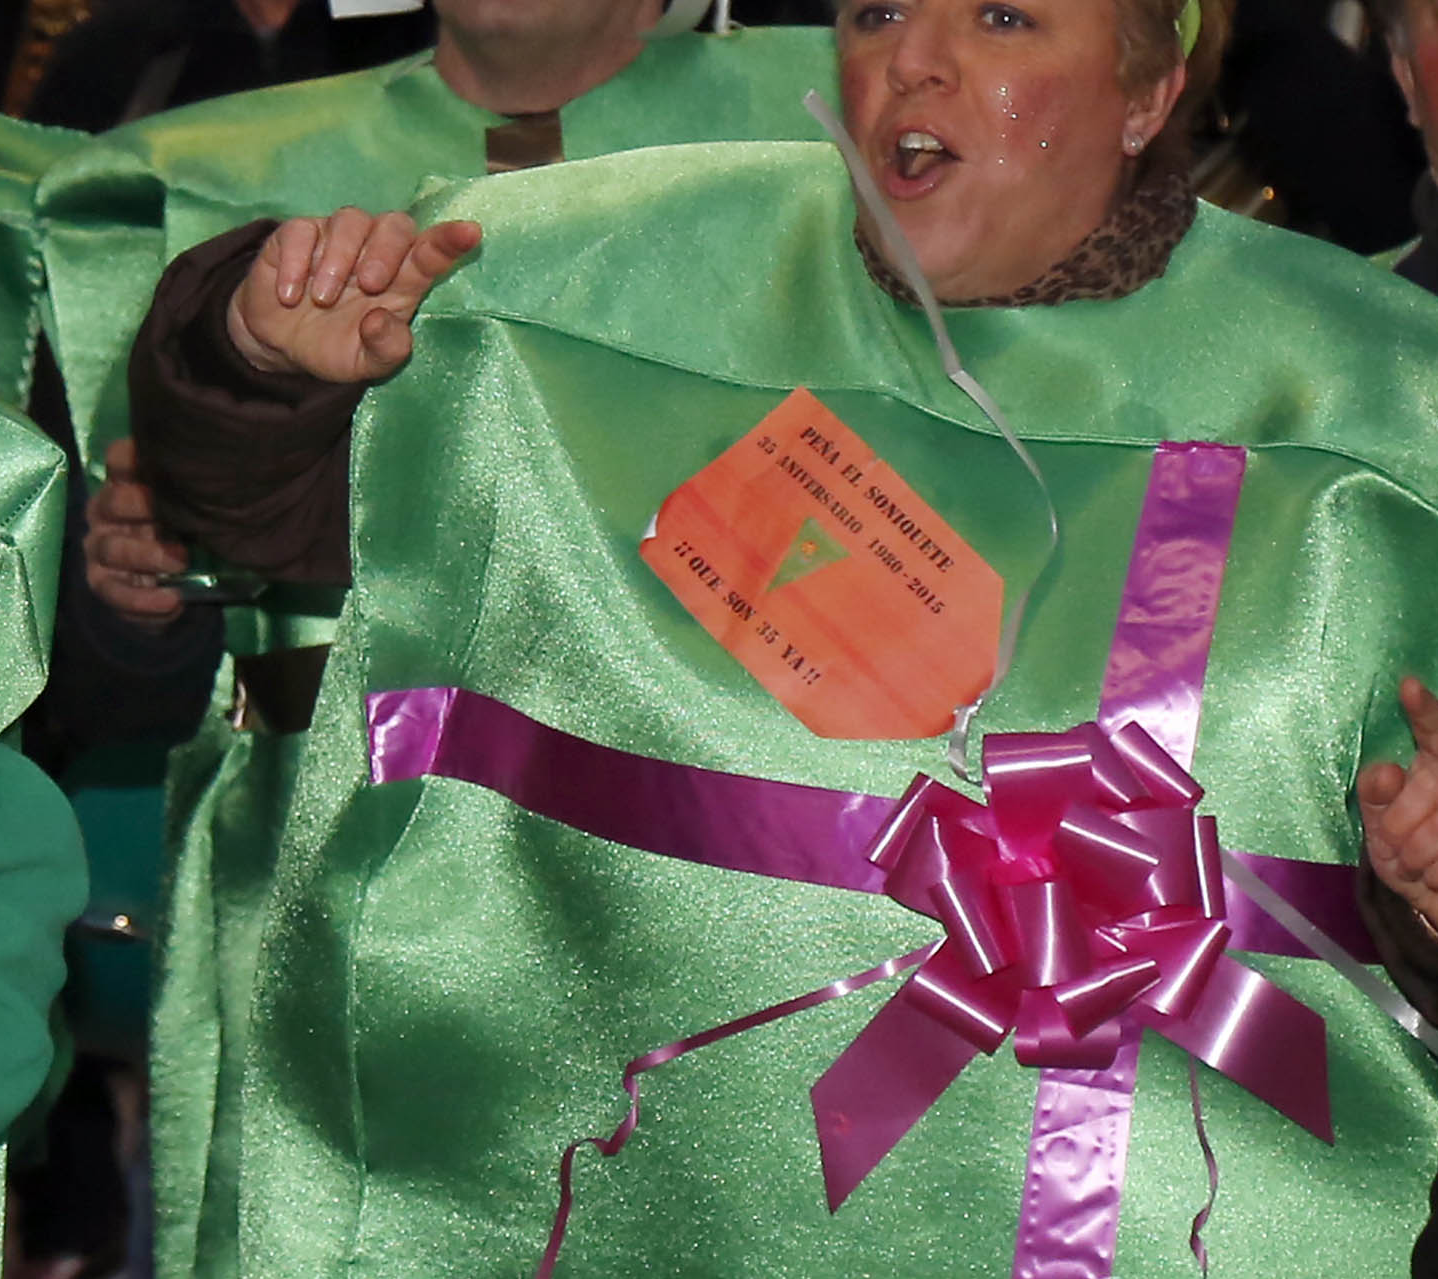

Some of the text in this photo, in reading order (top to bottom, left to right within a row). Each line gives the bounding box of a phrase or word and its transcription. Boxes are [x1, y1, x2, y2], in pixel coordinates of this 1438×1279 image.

[756, 436, 777, 456] 35
[775, 455, 863, 534] ANIVERSARIO
[799, 426, 954, 573] PEÑA EL SONIQUETE
[722, 591, 757, 622] SON
[755, 620, 780, 645] 35
